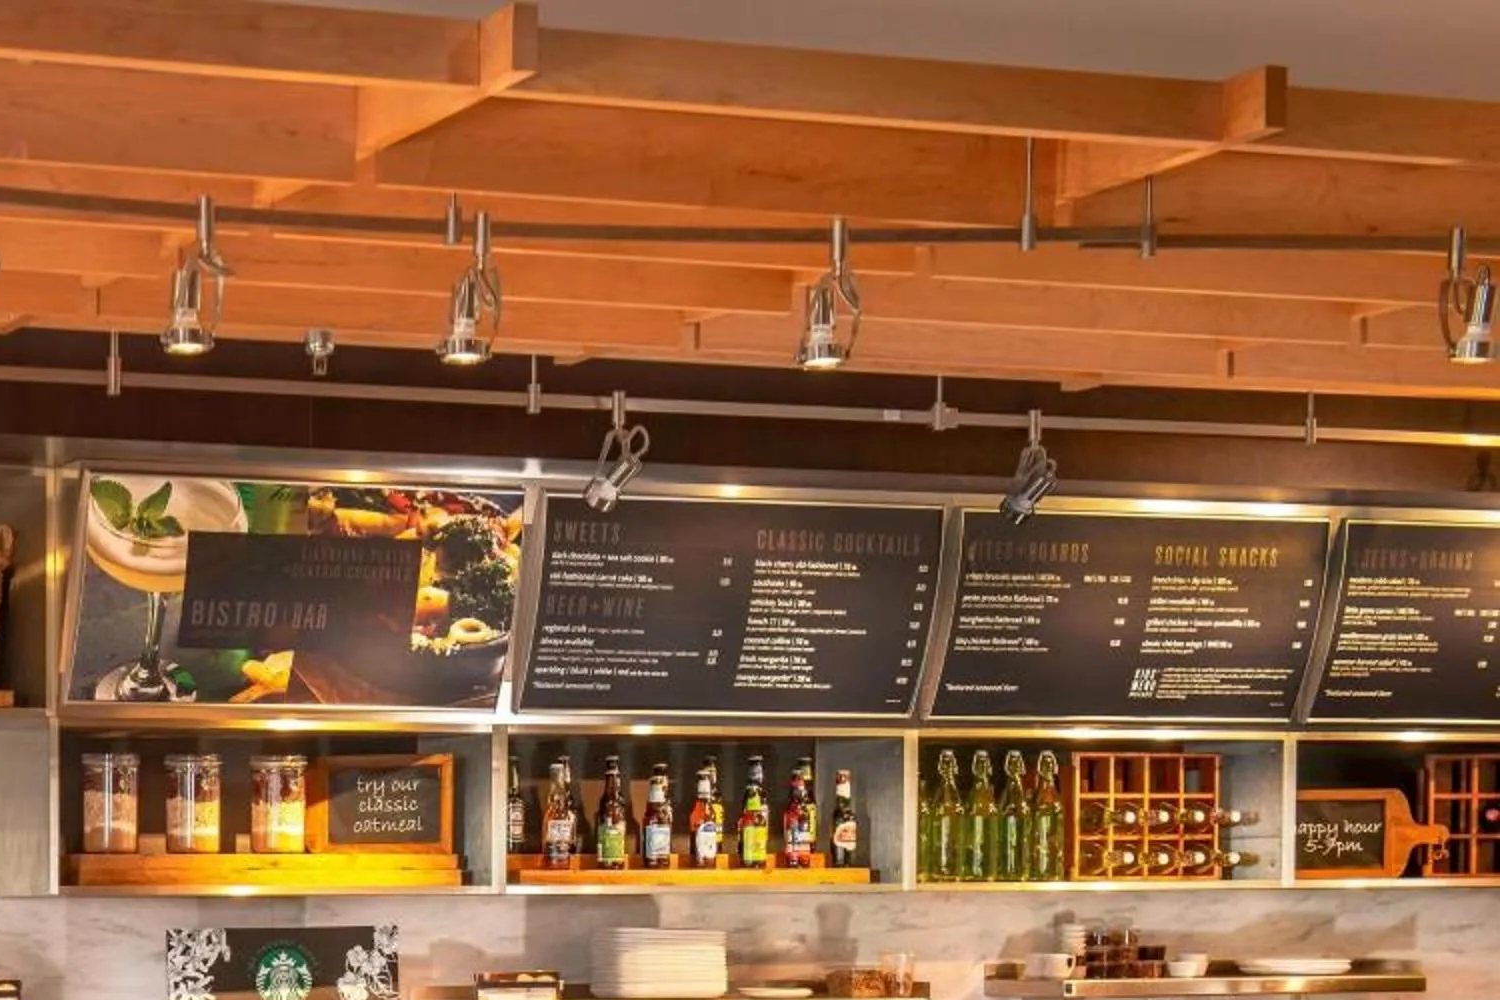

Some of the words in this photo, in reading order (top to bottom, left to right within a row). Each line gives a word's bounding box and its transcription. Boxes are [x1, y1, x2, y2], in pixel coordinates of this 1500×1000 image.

[553, 520, 621, 545] SWEETS
[756, 529, 826, 552] CLASSIC
[833, 531, 921, 556] COCKTAILS
[1155, 545, 1208, 567] SOCIAL
[1219, 546, 1278, 569] SNACKS
[190, 599, 277, 629] BISTRO
[291, 602, 329, 631] BAR
[602, 595, 645, 619] WINE
[356, 776, 385, 797] try
[391, 778, 421, 792] our
[359, 795, 419, 813] classic
[353, 815, 424, 833] oatmeal
[1297, 820, 1339, 840] appy
[1343, 818, 1382, 833] hour
[1304, 836, 1364, 857] 5-7pm
